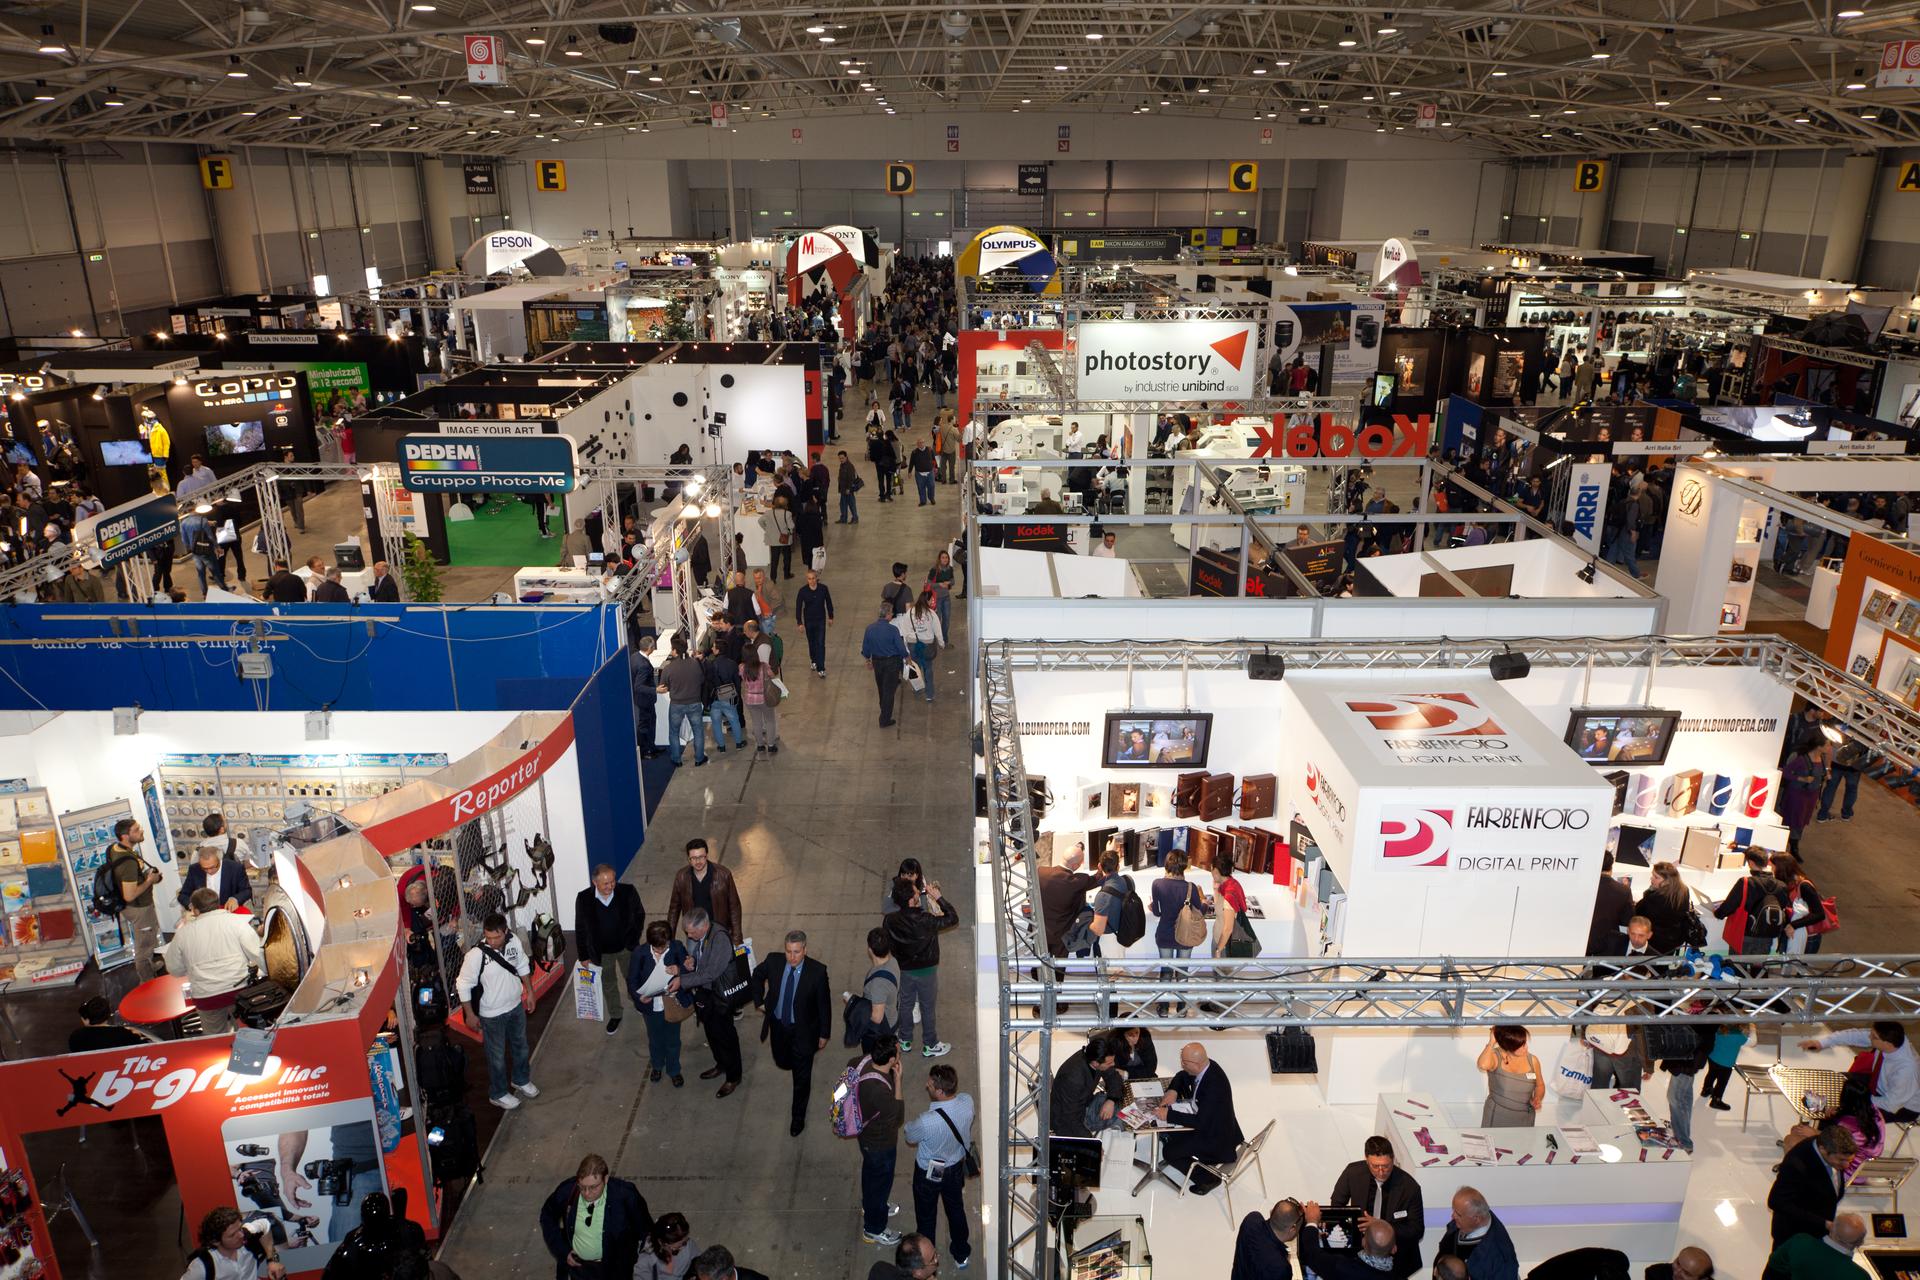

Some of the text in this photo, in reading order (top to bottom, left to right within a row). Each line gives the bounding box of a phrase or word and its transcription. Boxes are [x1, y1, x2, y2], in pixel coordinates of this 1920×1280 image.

[209, 160, 224, 186] F
[542, 162, 559, 189] E
[890, 166, 911, 191] D
[1233, 164, 1254, 190] C
[1579, 164, 1600, 190] B
[1900, 163, 1920, 188] A
[491, 236, 532, 248] EPSON
[802, 236, 814, 255] M
[982, 239, 1037, 250] OLYMPUS
[250, 335, 317, 344] ITALIA IN MINIATURA
[309, 366, 361, 379] Miniaturizzati
[1086, 350, 1211, 376] photostory
[195, 376, 297, 398] GoPro
[311, 378, 319, 388] in
[320, 377, 329, 387] 12
[1124, 379, 1239, 394] by industrie unibind spa
[447, 426, 535, 434] IMAGE YOUR ART
[405, 444, 476, 461] DEDEM
[1644, 444, 1656, 452] Arri
[1672, 444, 1682, 452] Srl
[410, 476, 566, 488] Gruppo Photo-Me
[1574, 484, 1600, 541] ARRI
[100, 516, 135, 541] DEDEM
[1017, 525, 1055, 537] Kodak
[105, 525, 177, 561] Gruppo Photo-Me
[1199, 568, 1223, 589] Kodak
[1677, 718, 1778, 733] WWW.ALBUMOPERA.COM
[1384, 739, 1509, 750] FARBENFOTO
[1399, 755, 1524, 764] DIGITAL PRINT
[450, 757, 540, 823] Reporter
[1467, 806, 1590, 830] FARBENFOTO
[1458, 857, 1579, 871] DIGITAL PRINT
[723, 980, 749, 998] FUJIFILM
[122, 1056, 168, 1075] The
[90, 1056, 328, 1110] b-grip line
[235, 1082, 329, 1104] Accessori innovativi
[238, 1095, 301, 1111] compatibilità
[302, 1091, 330, 1102] totale
